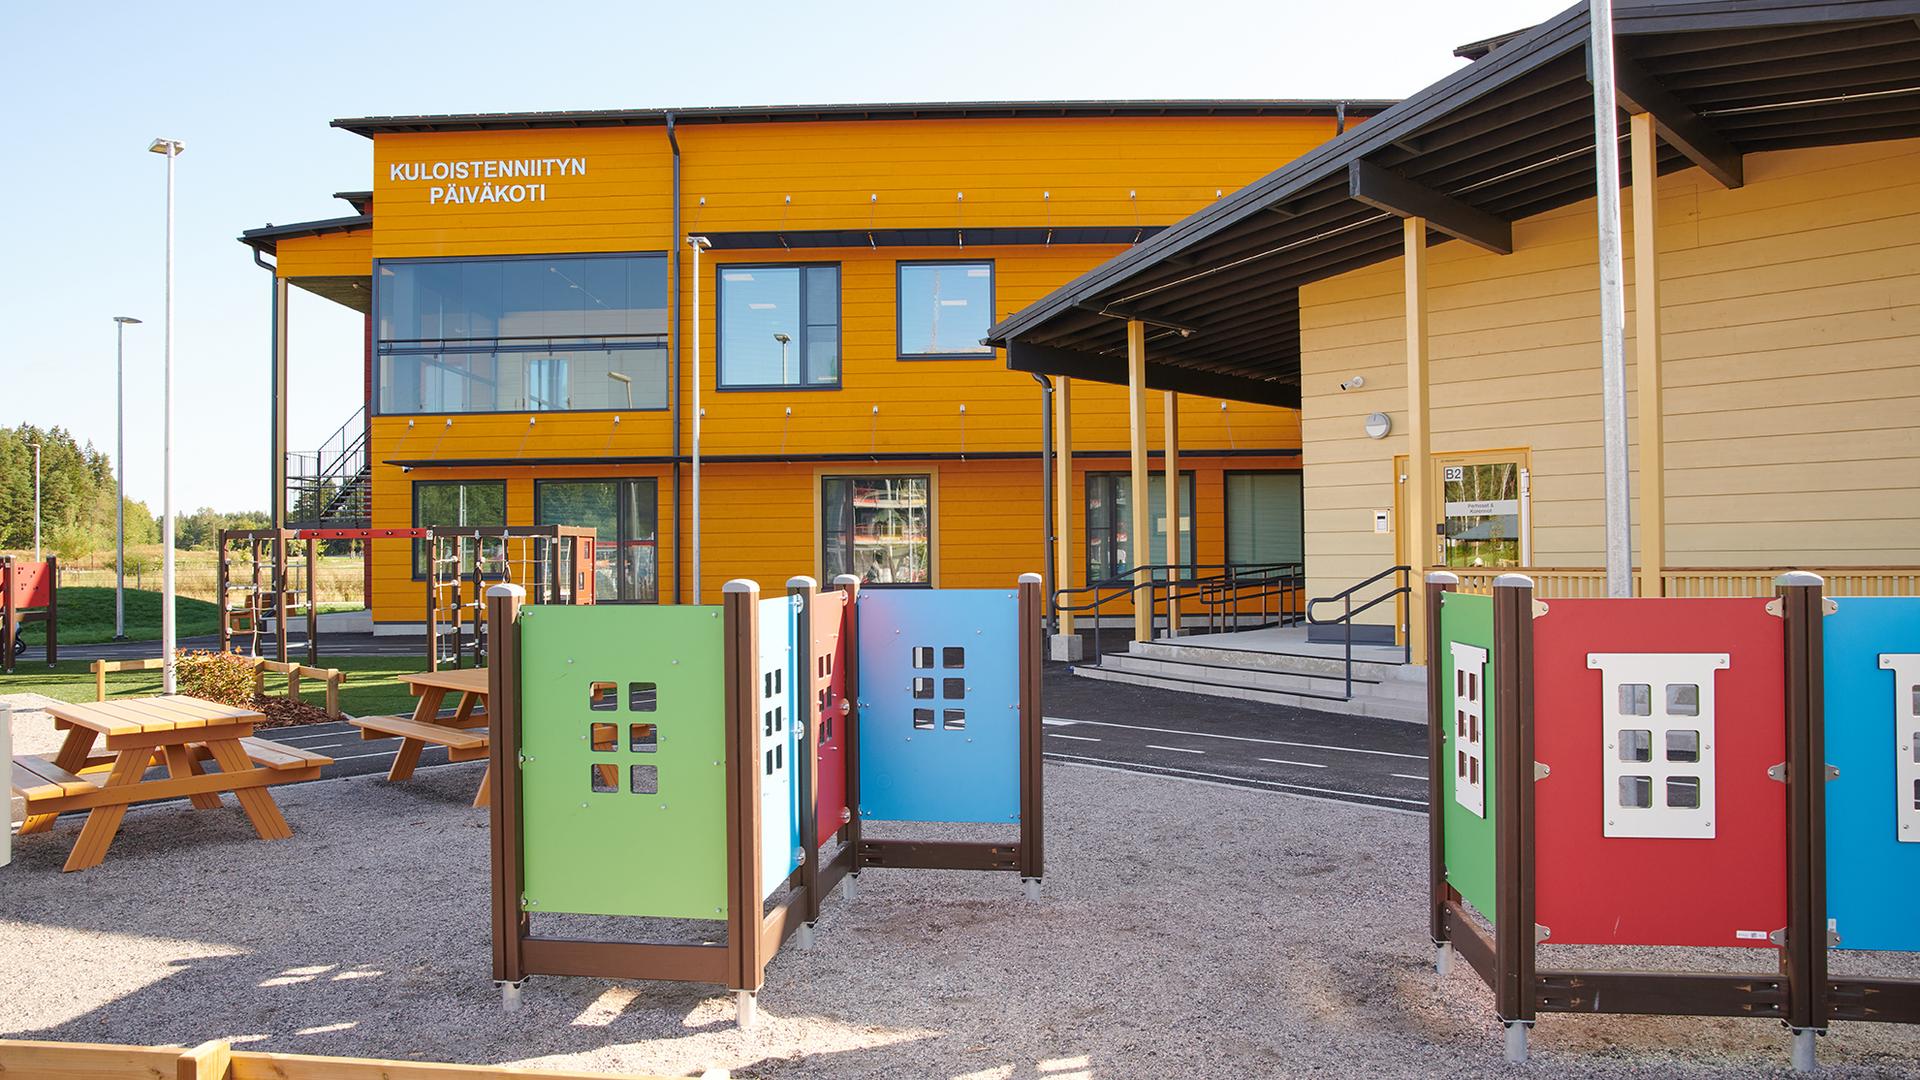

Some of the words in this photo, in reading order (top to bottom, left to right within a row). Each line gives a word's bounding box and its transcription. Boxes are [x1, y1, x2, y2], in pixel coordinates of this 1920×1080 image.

[390, 158, 587, 181] KULOISTENNIITYN
[430, 182, 546, 205] PÄIVÄKOTI
[1446, 468, 1462, 480] B2
